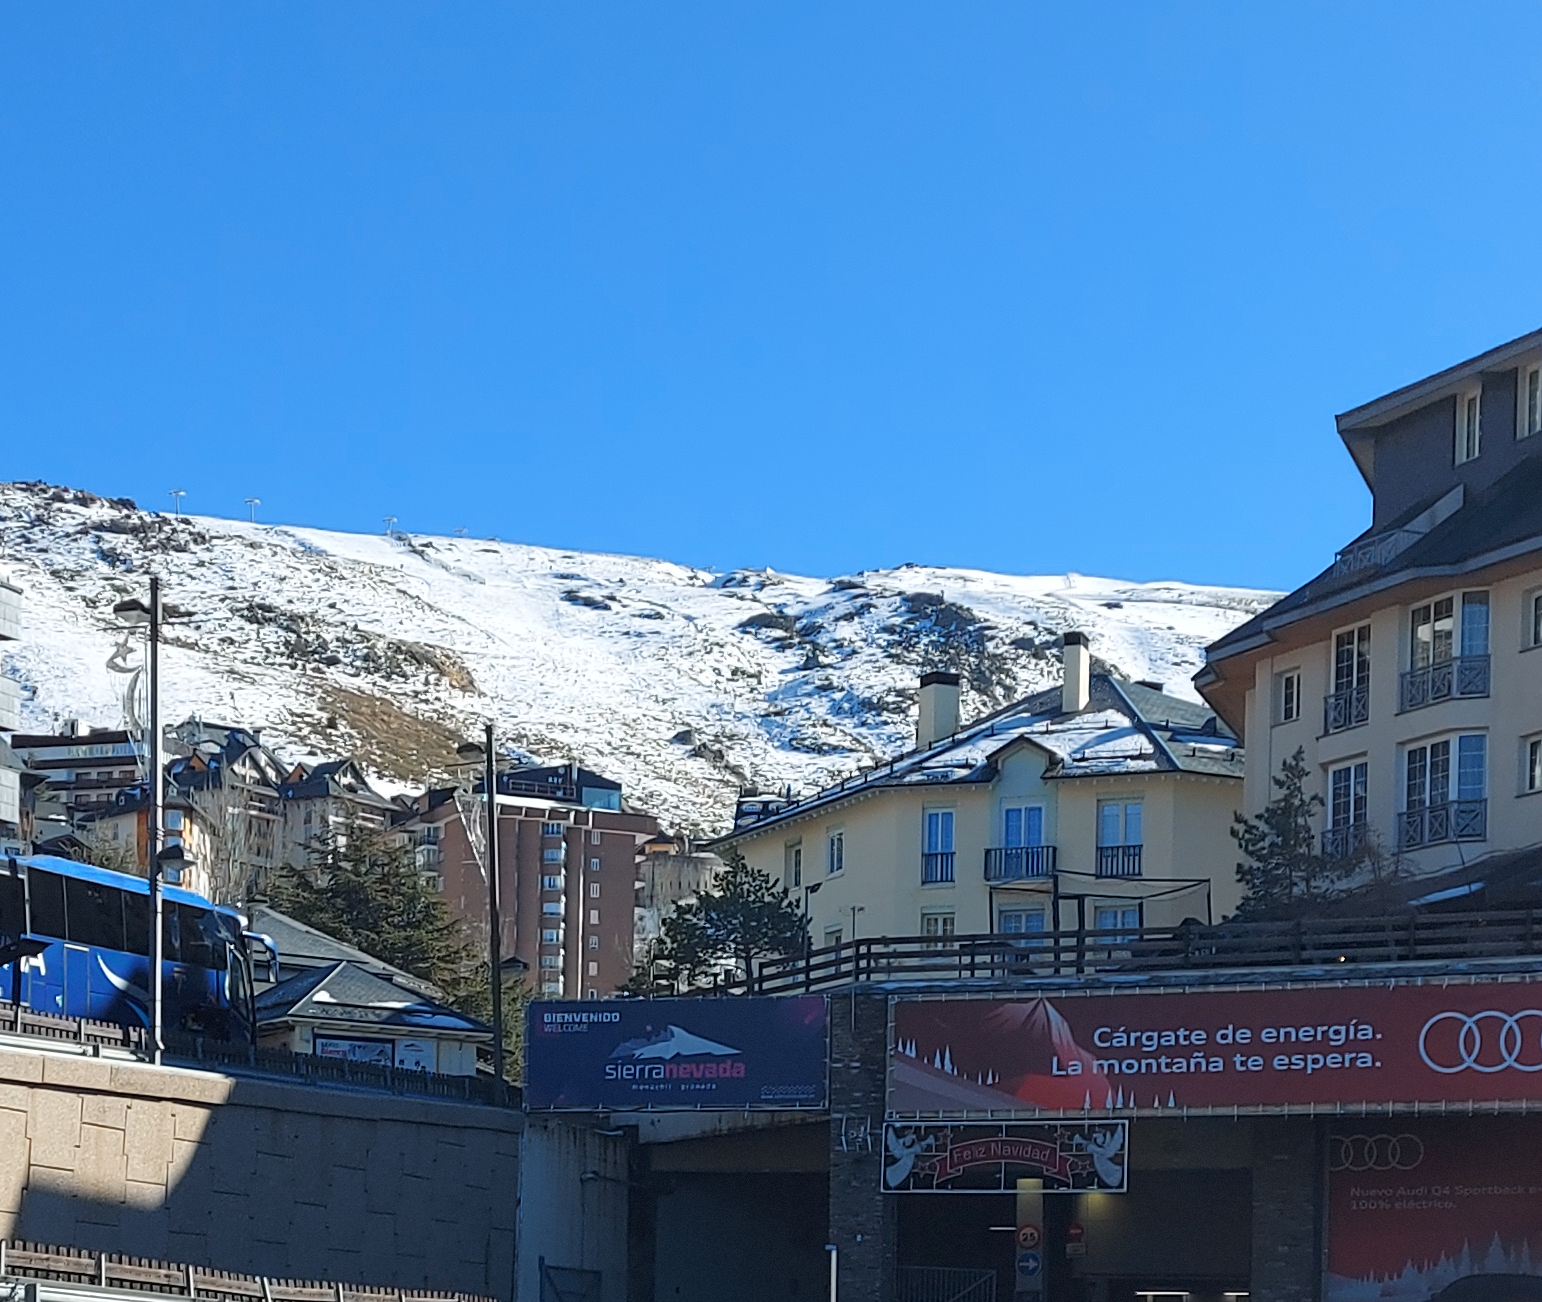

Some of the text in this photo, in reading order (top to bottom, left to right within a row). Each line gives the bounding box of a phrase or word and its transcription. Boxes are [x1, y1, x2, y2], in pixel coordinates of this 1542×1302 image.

[544, 1012, 620, 1023] BIENVENIDO
[544, 1023, 589, 1033] WELCOME
[1093, 1019, 1383, 1051] Cárgate de energía.
[1051, 1049, 1383, 1076] La montaña te espera.
[953, 1141, 1051, 1163] Feliz Navidad
[1350, 1186, 1393, 1197] Nuevo
[1396, 1186, 1428, 1196] Audi
[1351, 1199, 1391, 1210] 100%
